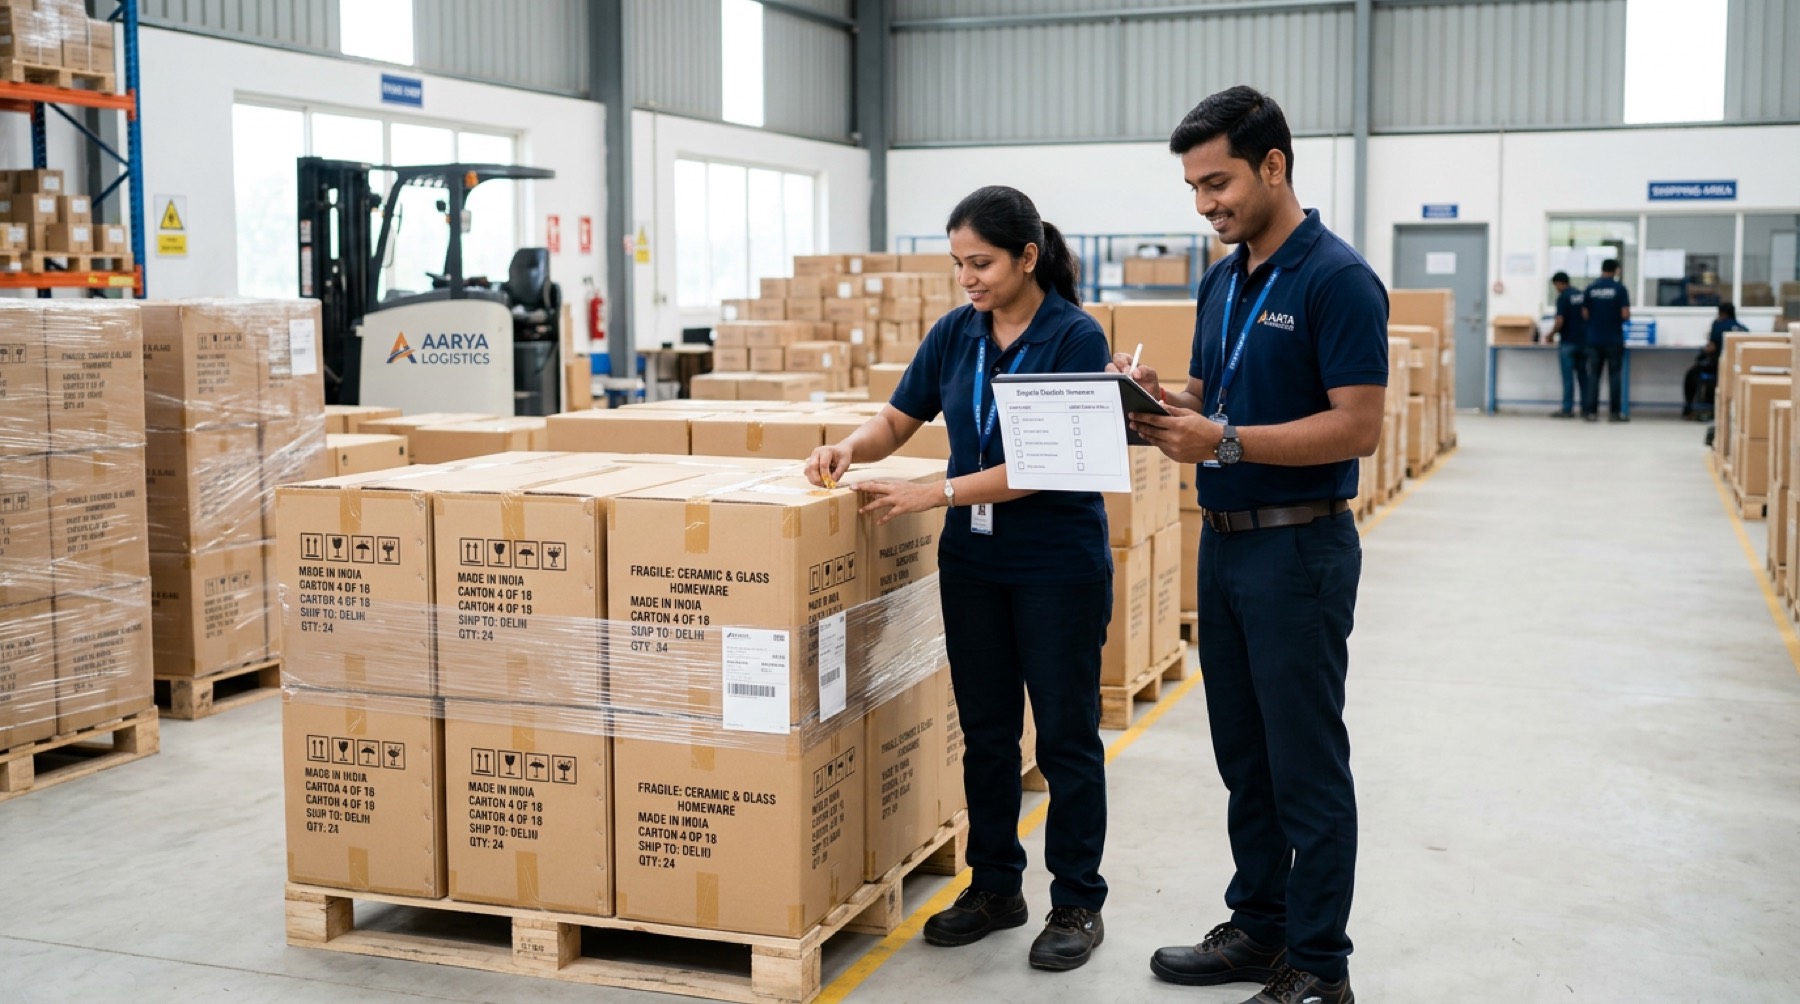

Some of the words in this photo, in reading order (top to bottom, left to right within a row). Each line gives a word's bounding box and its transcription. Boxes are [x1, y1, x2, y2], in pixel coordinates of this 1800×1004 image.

[422, 333, 489, 349] AARYA
[422, 353, 489, 364] LOGISTICS
[327, 568, 335, 578] IN
[458, 572, 484, 583] MADE
[487, 574, 496, 584] IN
[631, 565, 674, 578] FRAGILE:
[678, 568, 722, 581] CERAMIC
[726, 571, 733, 582] &
[736, 571, 769, 583] GLASS
[337, 583, 342, 591] 4
[670, 583, 729, 596] HOMEWARE
[338, 596, 343, 605] 4
[497, 589, 504, 599] 4
[506, 590, 518, 599] OF
[521, 590, 532, 600] 18
[497, 603, 504, 613] 4
[631, 596, 658, 608] MADE
[662, 598, 671, 608] IN
[323, 609, 337, 619] TO:
[631, 611, 670, 624] CARTON
[673, 614, 679, 624] 4
[683, 615, 695, 625] OF
[698, 615, 710, 625] 18
[482, 616, 497, 627] TO:
[482, 630, 493, 641] 24
[332, 770, 340, 779] IN
[342, 785, 347, 794] 4
[468, 782, 495, 793] MADE
[497, 785, 506, 794] IN
[638, 782, 682, 796] FRAGILE:
[685, 786, 729, 801] CERAMIC
[733, 790, 740, 801] &
[342, 799, 348, 808] 4
[508, 799, 514, 809] 4
[531, 802, 543, 812] 18
[678, 801, 735, 816] HOMEWARE
[329, 810, 342, 820] TO:
[508, 813, 514, 823] 4
[531, 816, 543, 826] 18
[638, 812, 666, 824] MADE
[670, 816, 679, 826] IN
[470, 823, 491, 835] SHIP
[493, 825, 508, 836] TO:
[470, 837, 490, 849] QTY:
[493, 839, 504, 850] 24
[680, 831, 687, 840] 4
[705, 833, 717, 844] 18
[638, 841, 661, 852] SHIP
[663, 843, 679, 855] TO:
[639, 855, 661, 867] QTY:
[663, 857, 675, 868] 24
